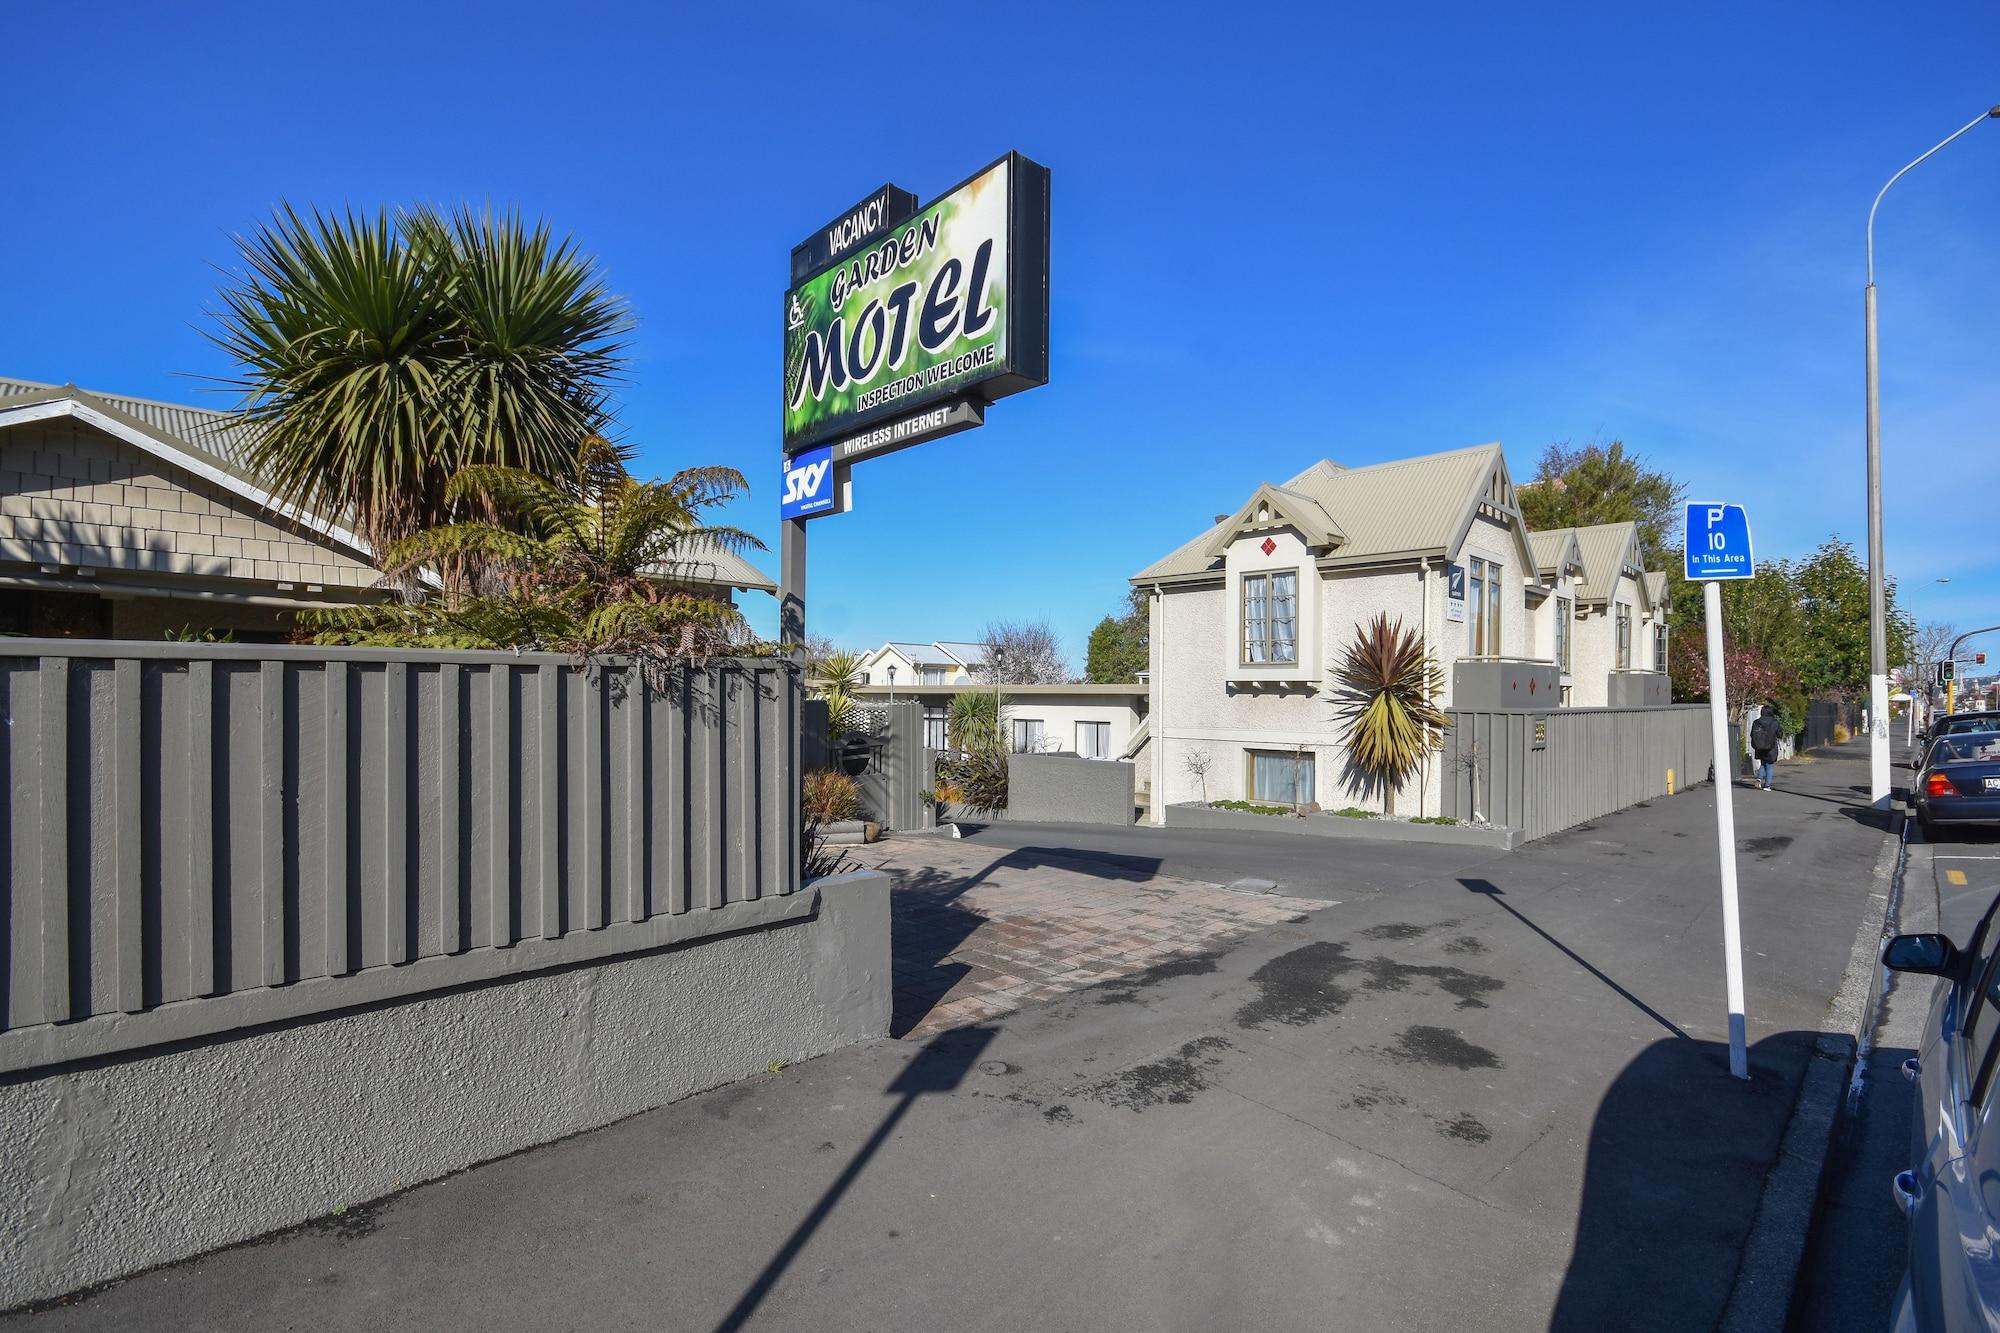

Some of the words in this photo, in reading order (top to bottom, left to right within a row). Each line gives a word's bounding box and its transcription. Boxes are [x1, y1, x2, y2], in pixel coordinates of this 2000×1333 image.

[829, 195, 885, 256] VACANCY
[831, 211, 941, 312] GARDEN
[791, 238, 998, 412] MOTEL
[857, 371, 925, 412] INSPECTION
[927, 344, 995, 387] WELCOME
[843, 428, 891, 454] WIRELESS
[894, 407, 950, 439] INTERNET
[782, 459, 830, 505] SKY
[1707, 508, 1724, 529] P
[1707, 532, 1726, 550] 10
[1692, 554, 1700, 564] In
[1702, 554, 1721, 564] This
[1724, 553, 1745, 563] Area
